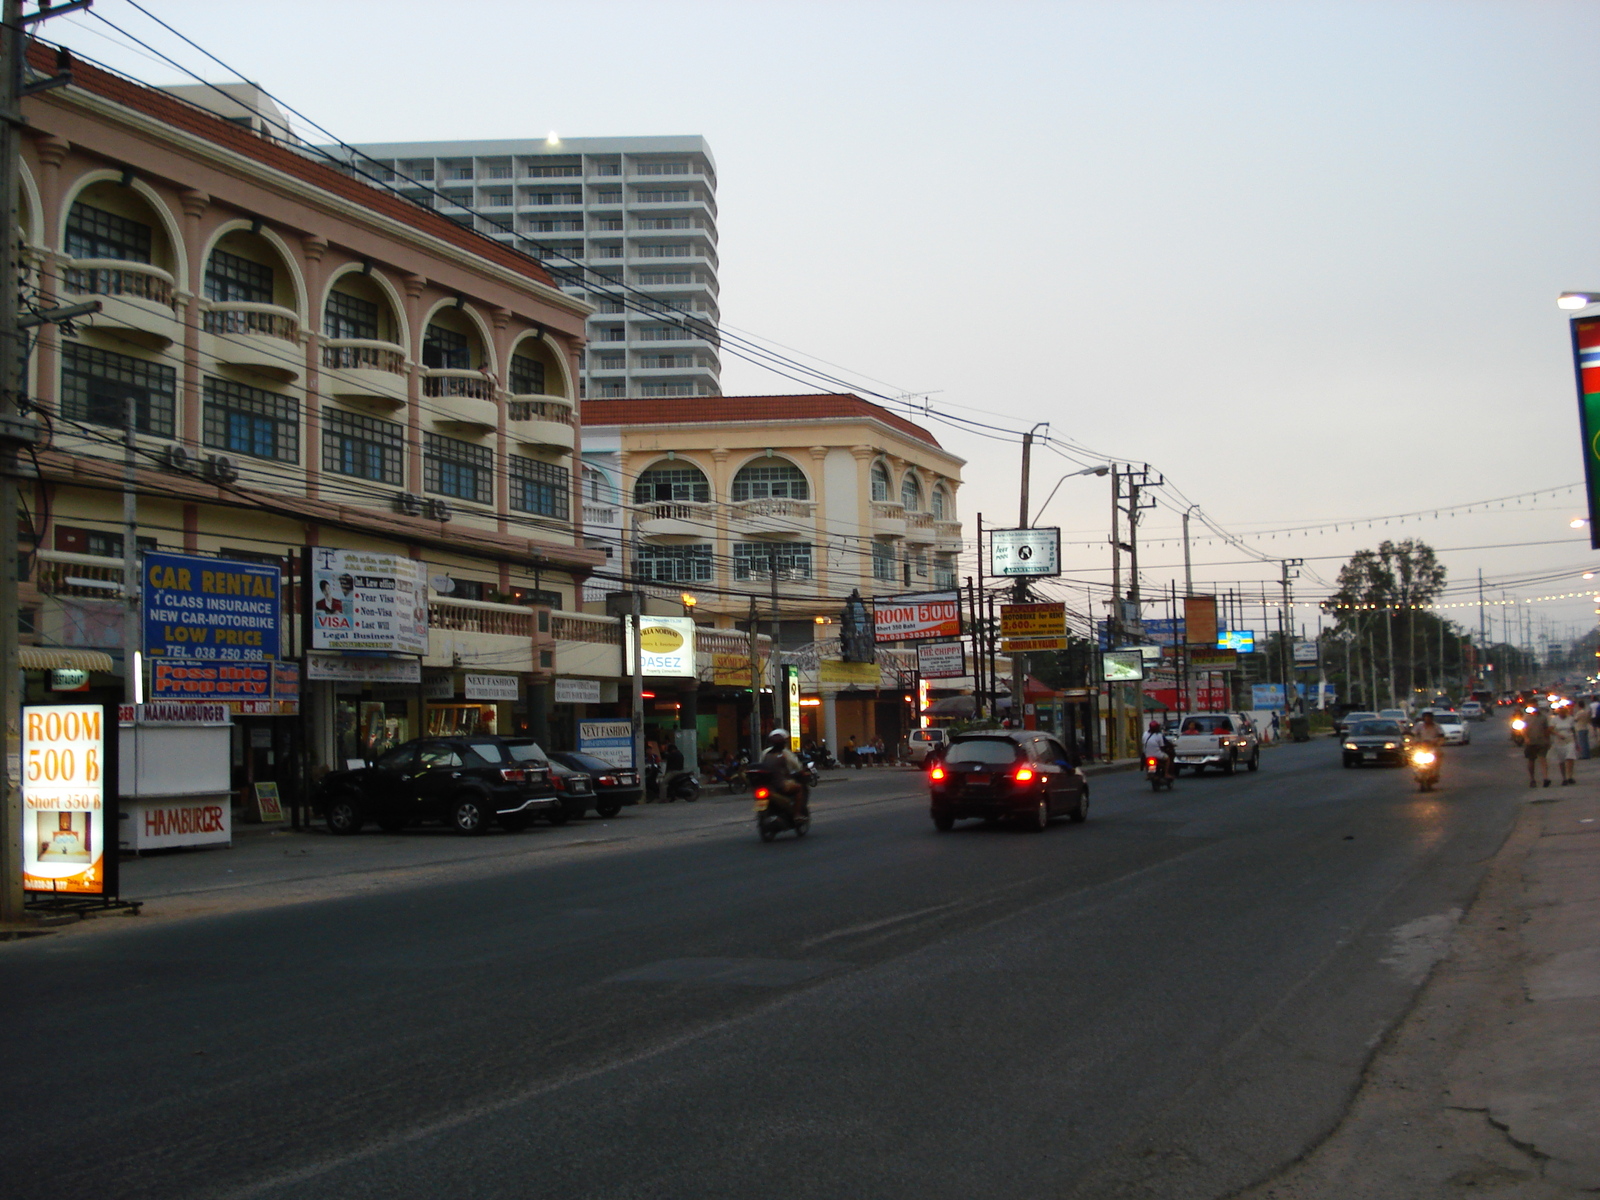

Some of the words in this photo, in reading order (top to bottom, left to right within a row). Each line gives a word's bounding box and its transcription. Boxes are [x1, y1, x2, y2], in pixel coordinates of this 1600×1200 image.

[150, 565, 192, 591] CAR
[202, 570, 275, 599] RENTAL
[164, 594, 203, 608] CLASS
[207, 598, 271, 614] INSURANCE
[360, 593, 376, 602] Year
[380, 594, 394, 603] Visa
[150, 609, 178, 622] NEW
[181, 612, 274, 628] CAR-MOTORBIKE
[360, 607, 392, 617] Non-Visa
[875, 607, 914, 624] ROOM
[920, 605, 954, 620] 500
[318, 616, 350, 628] VISA
[362, 621, 375, 629] Last
[164, 626, 207, 643] LOW
[215, 628, 262, 646] PRICE
[655, 628, 678, 638] NORWAY
[166, 645, 191, 658] TEL.
[195, 647, 216, 659] 038
[220, 648, 240, 660] 250
[244, 649, 263, 660] 568
[920, 648, 934, 656] THE
[935, 646, 960, 656] CHIPPY
[156, 666, 267, 680] Possible
[156, 679, 267, 693] Property
[468, 677, 485, 685] NEXT
[488, 677, 516, 686] FASHION
[144, 704, 224, 722] MAMAHAMBURGER
[28, 711, 100, 742] ROOM
[582, 726, 599, 736] NEXT
[602, 726, 630, 736] FASHION
[28, 748, 75, 782] 500
[26, 793, 60, 809] Short
[64, 794, 89, 809] 350
[145, 806, 224, 836] HAMBURGER
